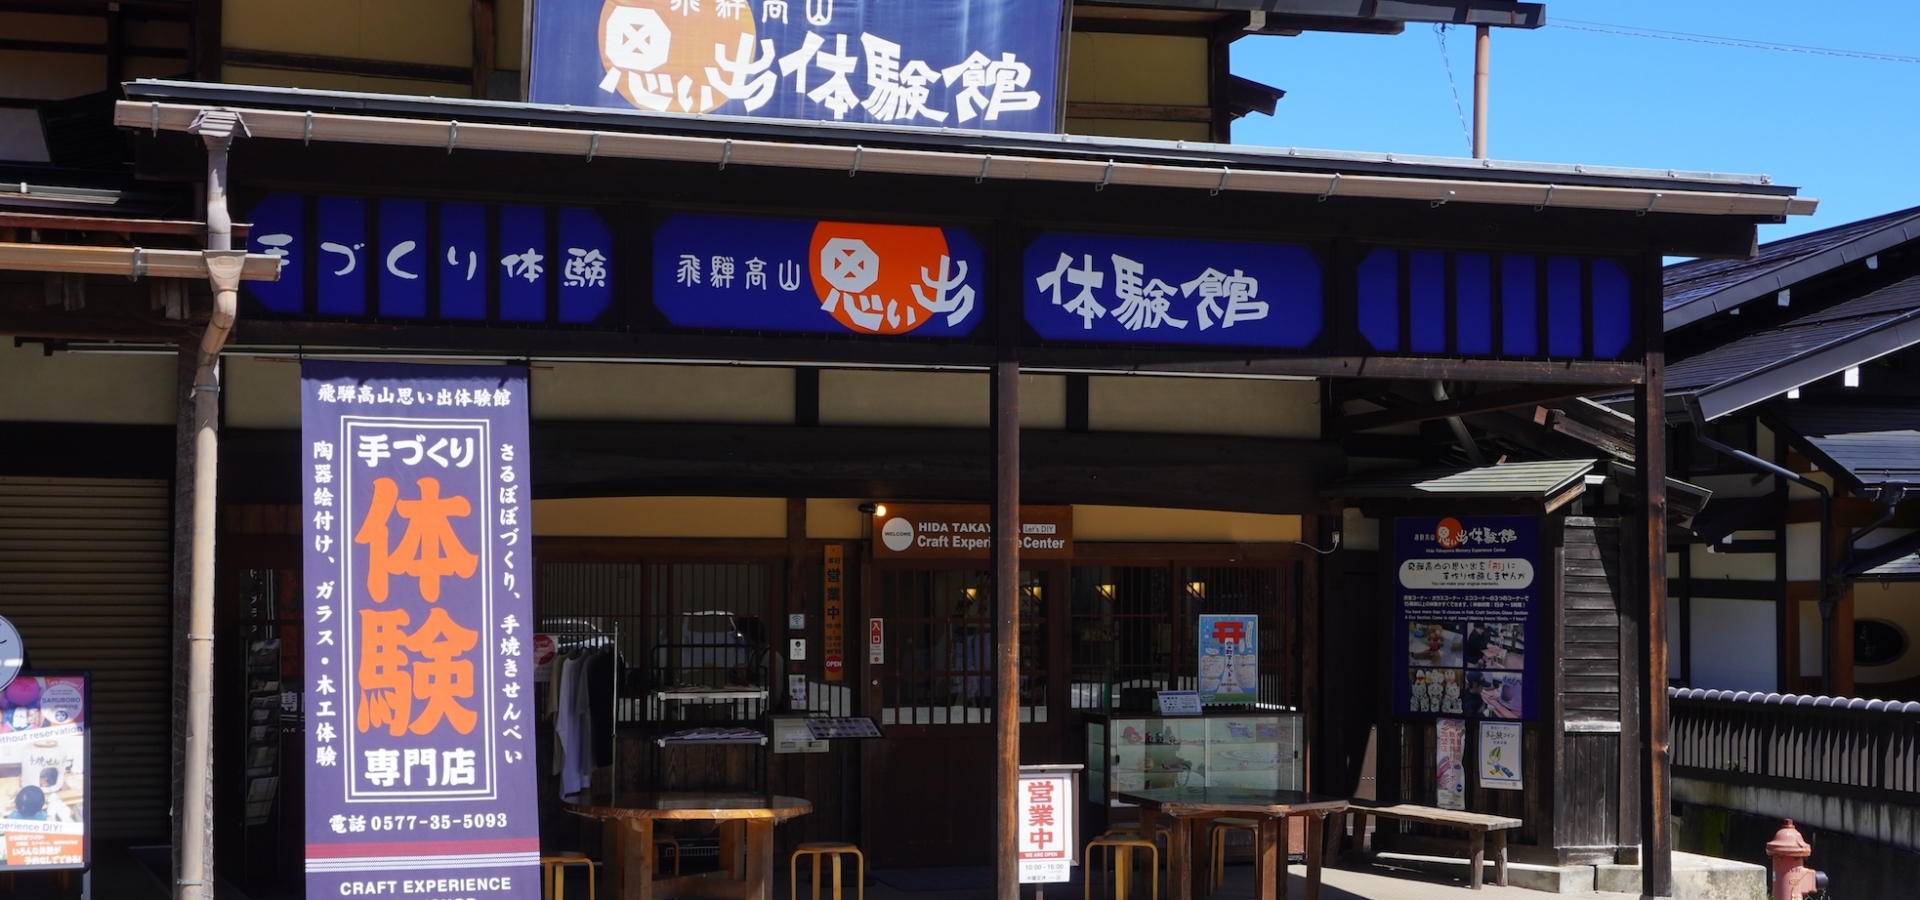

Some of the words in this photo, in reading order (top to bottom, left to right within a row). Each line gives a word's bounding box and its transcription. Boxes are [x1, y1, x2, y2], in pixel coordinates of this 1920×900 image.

[600, 6, 1040, 122] 思い出体験館
[677, 254, 800, 291] 飛騨高山
[820, 237, 975, 331] 思い出
[1036, 252, 1269, 331] 体験館
[318, 384, 511, 407] 飛騨高山思い出体験館
[357, 434, 474, 468] 手づくり
[918, 522, 949, 533] HIDA
[1024, 525, 1039, 533] Let's
[1041, 525, 1054, 533] DIY
[917, 535, 949, 548] Craft
[952, 535, 1022, 550] Experie
[1023, 536, 1065, 549] Center
[354, 477, 479, 736] 体験
[827, 568, 841, 620] 営業中
[872, 621, 881, 643] 入口
[30, 725, 83, 739] reservation
[364, 748, 475, 787] 専門店
[329, 815, 366, 833] 電話
[371, 813, 508, 830] 0577-35-5093
[1028, 781, 1054, 850] 営業中
[340, 880, 397, 896] CRAFT
[403, 877, 511, 894] EXPERIENCE
